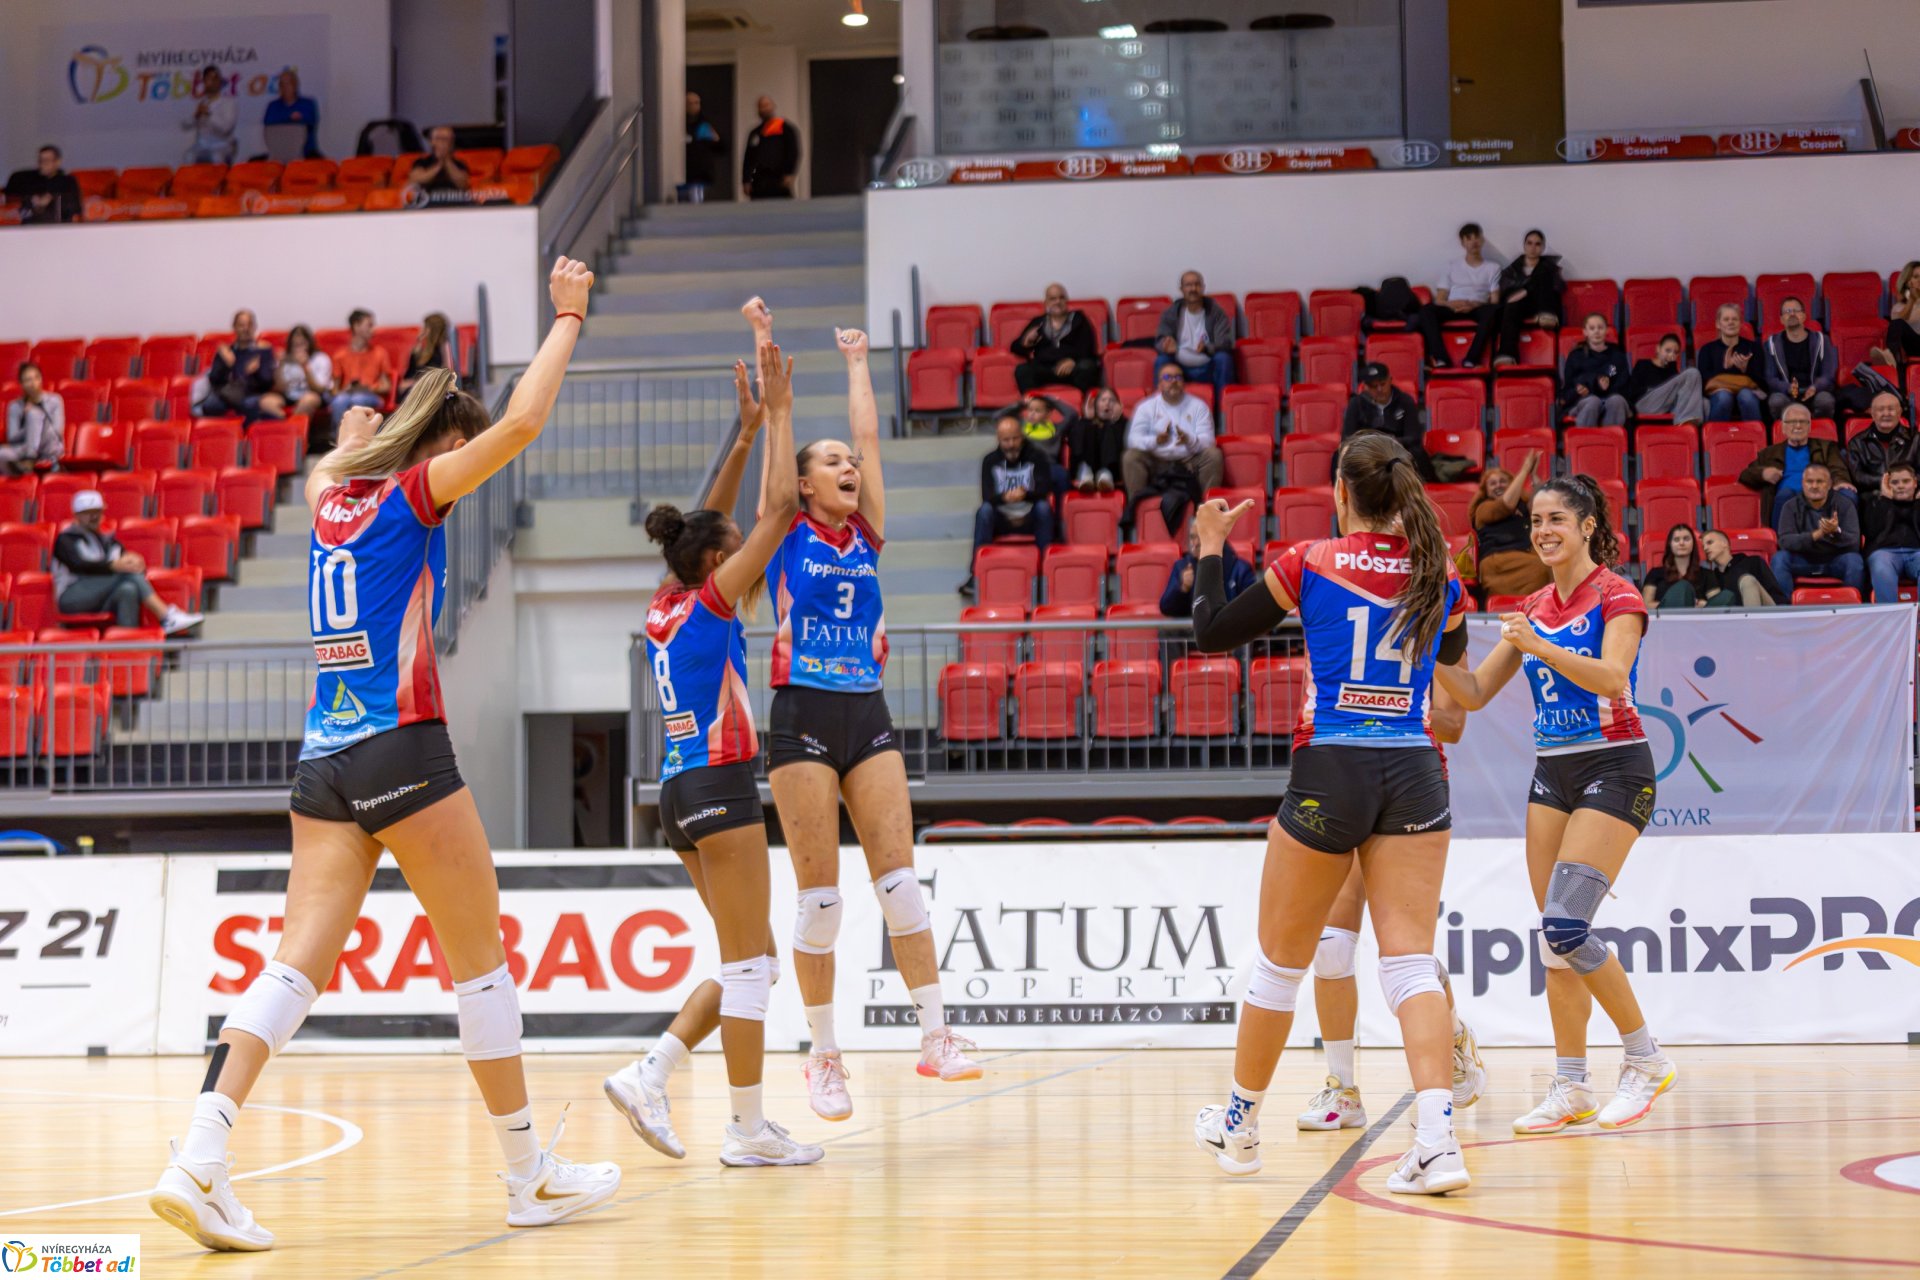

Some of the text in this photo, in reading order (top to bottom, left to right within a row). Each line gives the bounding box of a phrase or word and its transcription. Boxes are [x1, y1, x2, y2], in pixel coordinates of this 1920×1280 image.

[1739, 131, 1773, 150] BH
[1066, 156, 1097, 175] BH
[1231, 149, 1263, 169] BH
[312, 549, 358, 632] 10
[834, 582, 856, 619] 3
[1346, 605, 1418, 685] 14
[654, 649, 677, 712] 8
[1536, 667, 1559, 703] 2
[1341, 693, 1410, 709] STRABAG
[1648, 808, 1712, 827] GYAR
[39, 907, 119, 959] 21
[868, 974, 1235, 1000] POPERTY
[870, 1002, 1232, 1025] INGTLANBERUHÁZÓ KFT
